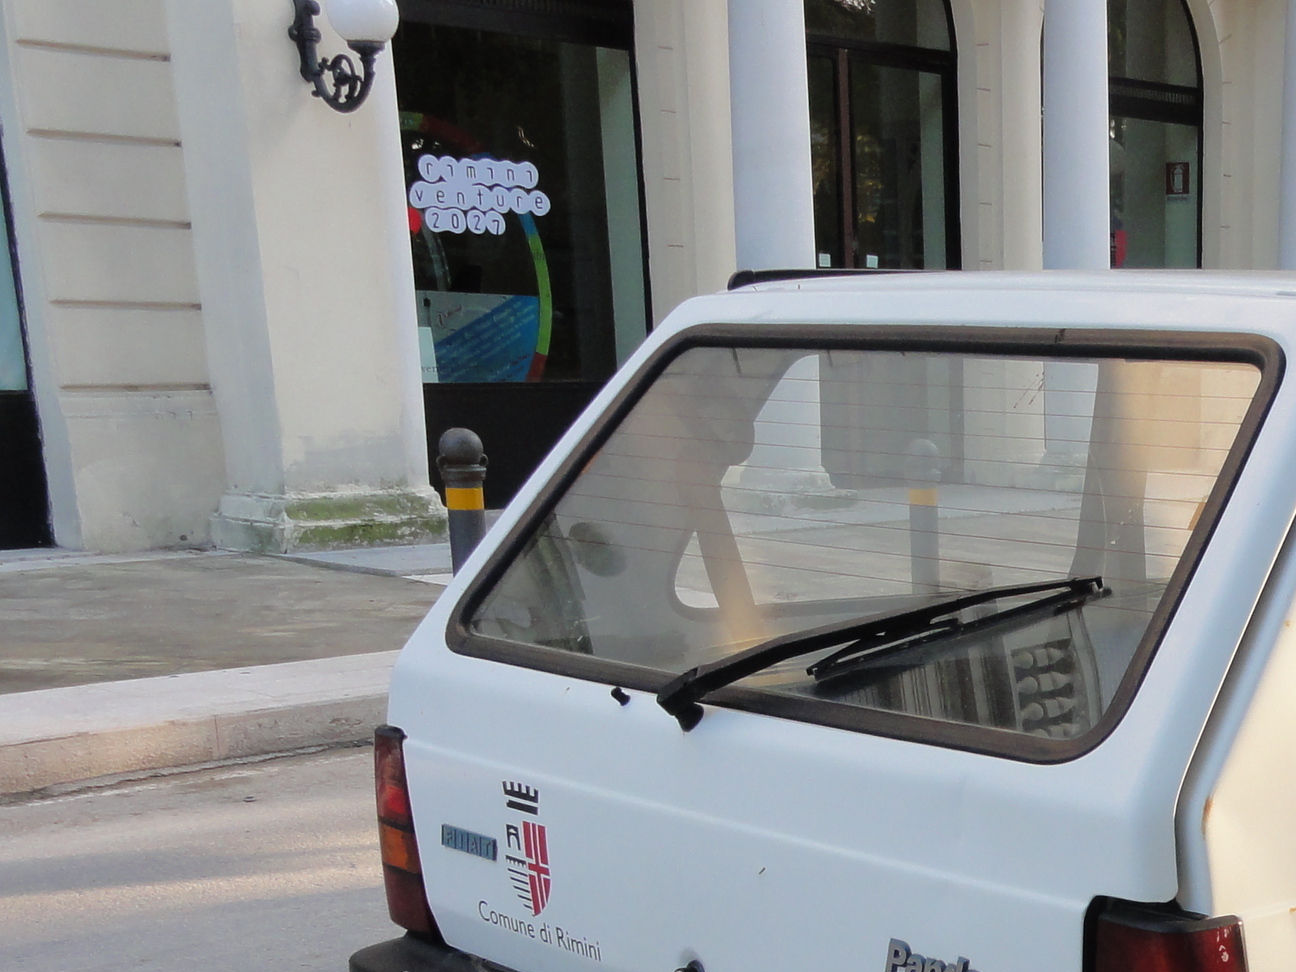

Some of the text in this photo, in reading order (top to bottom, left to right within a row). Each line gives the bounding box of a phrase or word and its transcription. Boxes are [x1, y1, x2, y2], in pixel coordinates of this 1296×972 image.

[415, 189, 543, 210] venture
[432, 212, 500, 235] 2027
[441, 824, 497, 861] FIAT
[478, 900, 602, 961] Comune di Rimini
